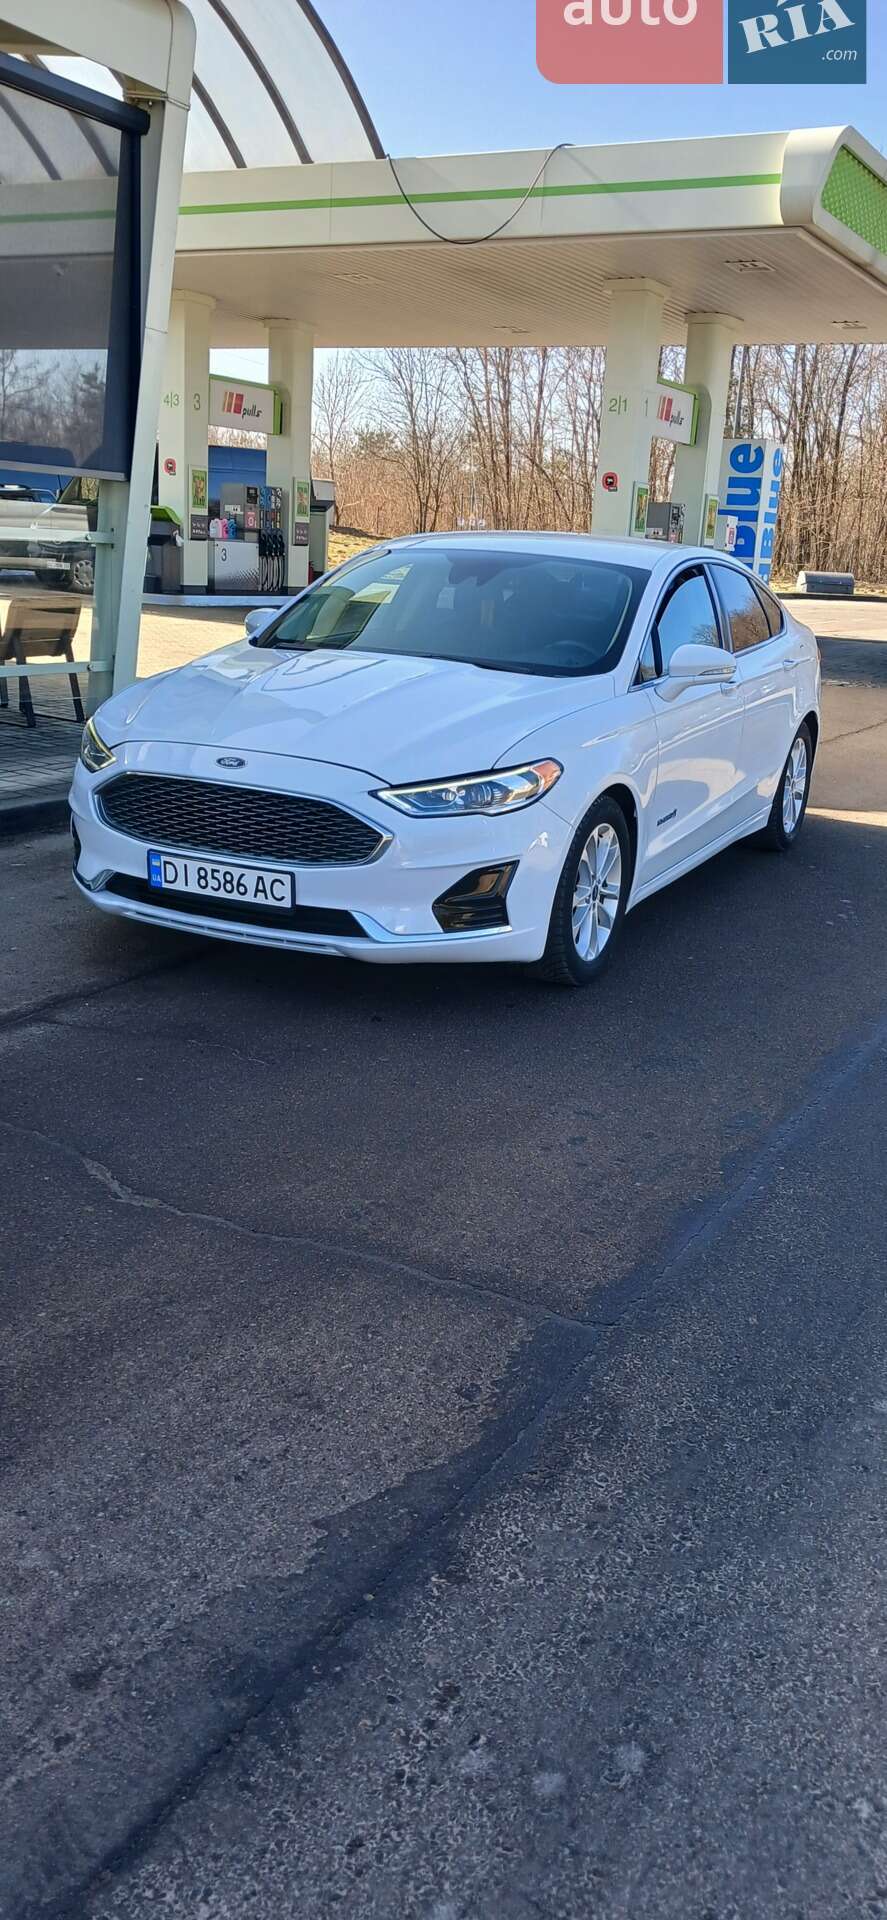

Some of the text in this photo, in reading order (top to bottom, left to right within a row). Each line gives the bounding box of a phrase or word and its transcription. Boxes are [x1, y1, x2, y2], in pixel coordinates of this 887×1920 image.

[193, 393, 201, 411] 3
[718, 443, 765, 570] Blue
[220, 548, 227, 562] 3
[152, 873, 162, 882] UA
[163, 860, 286, 902] DI 8586 AC
